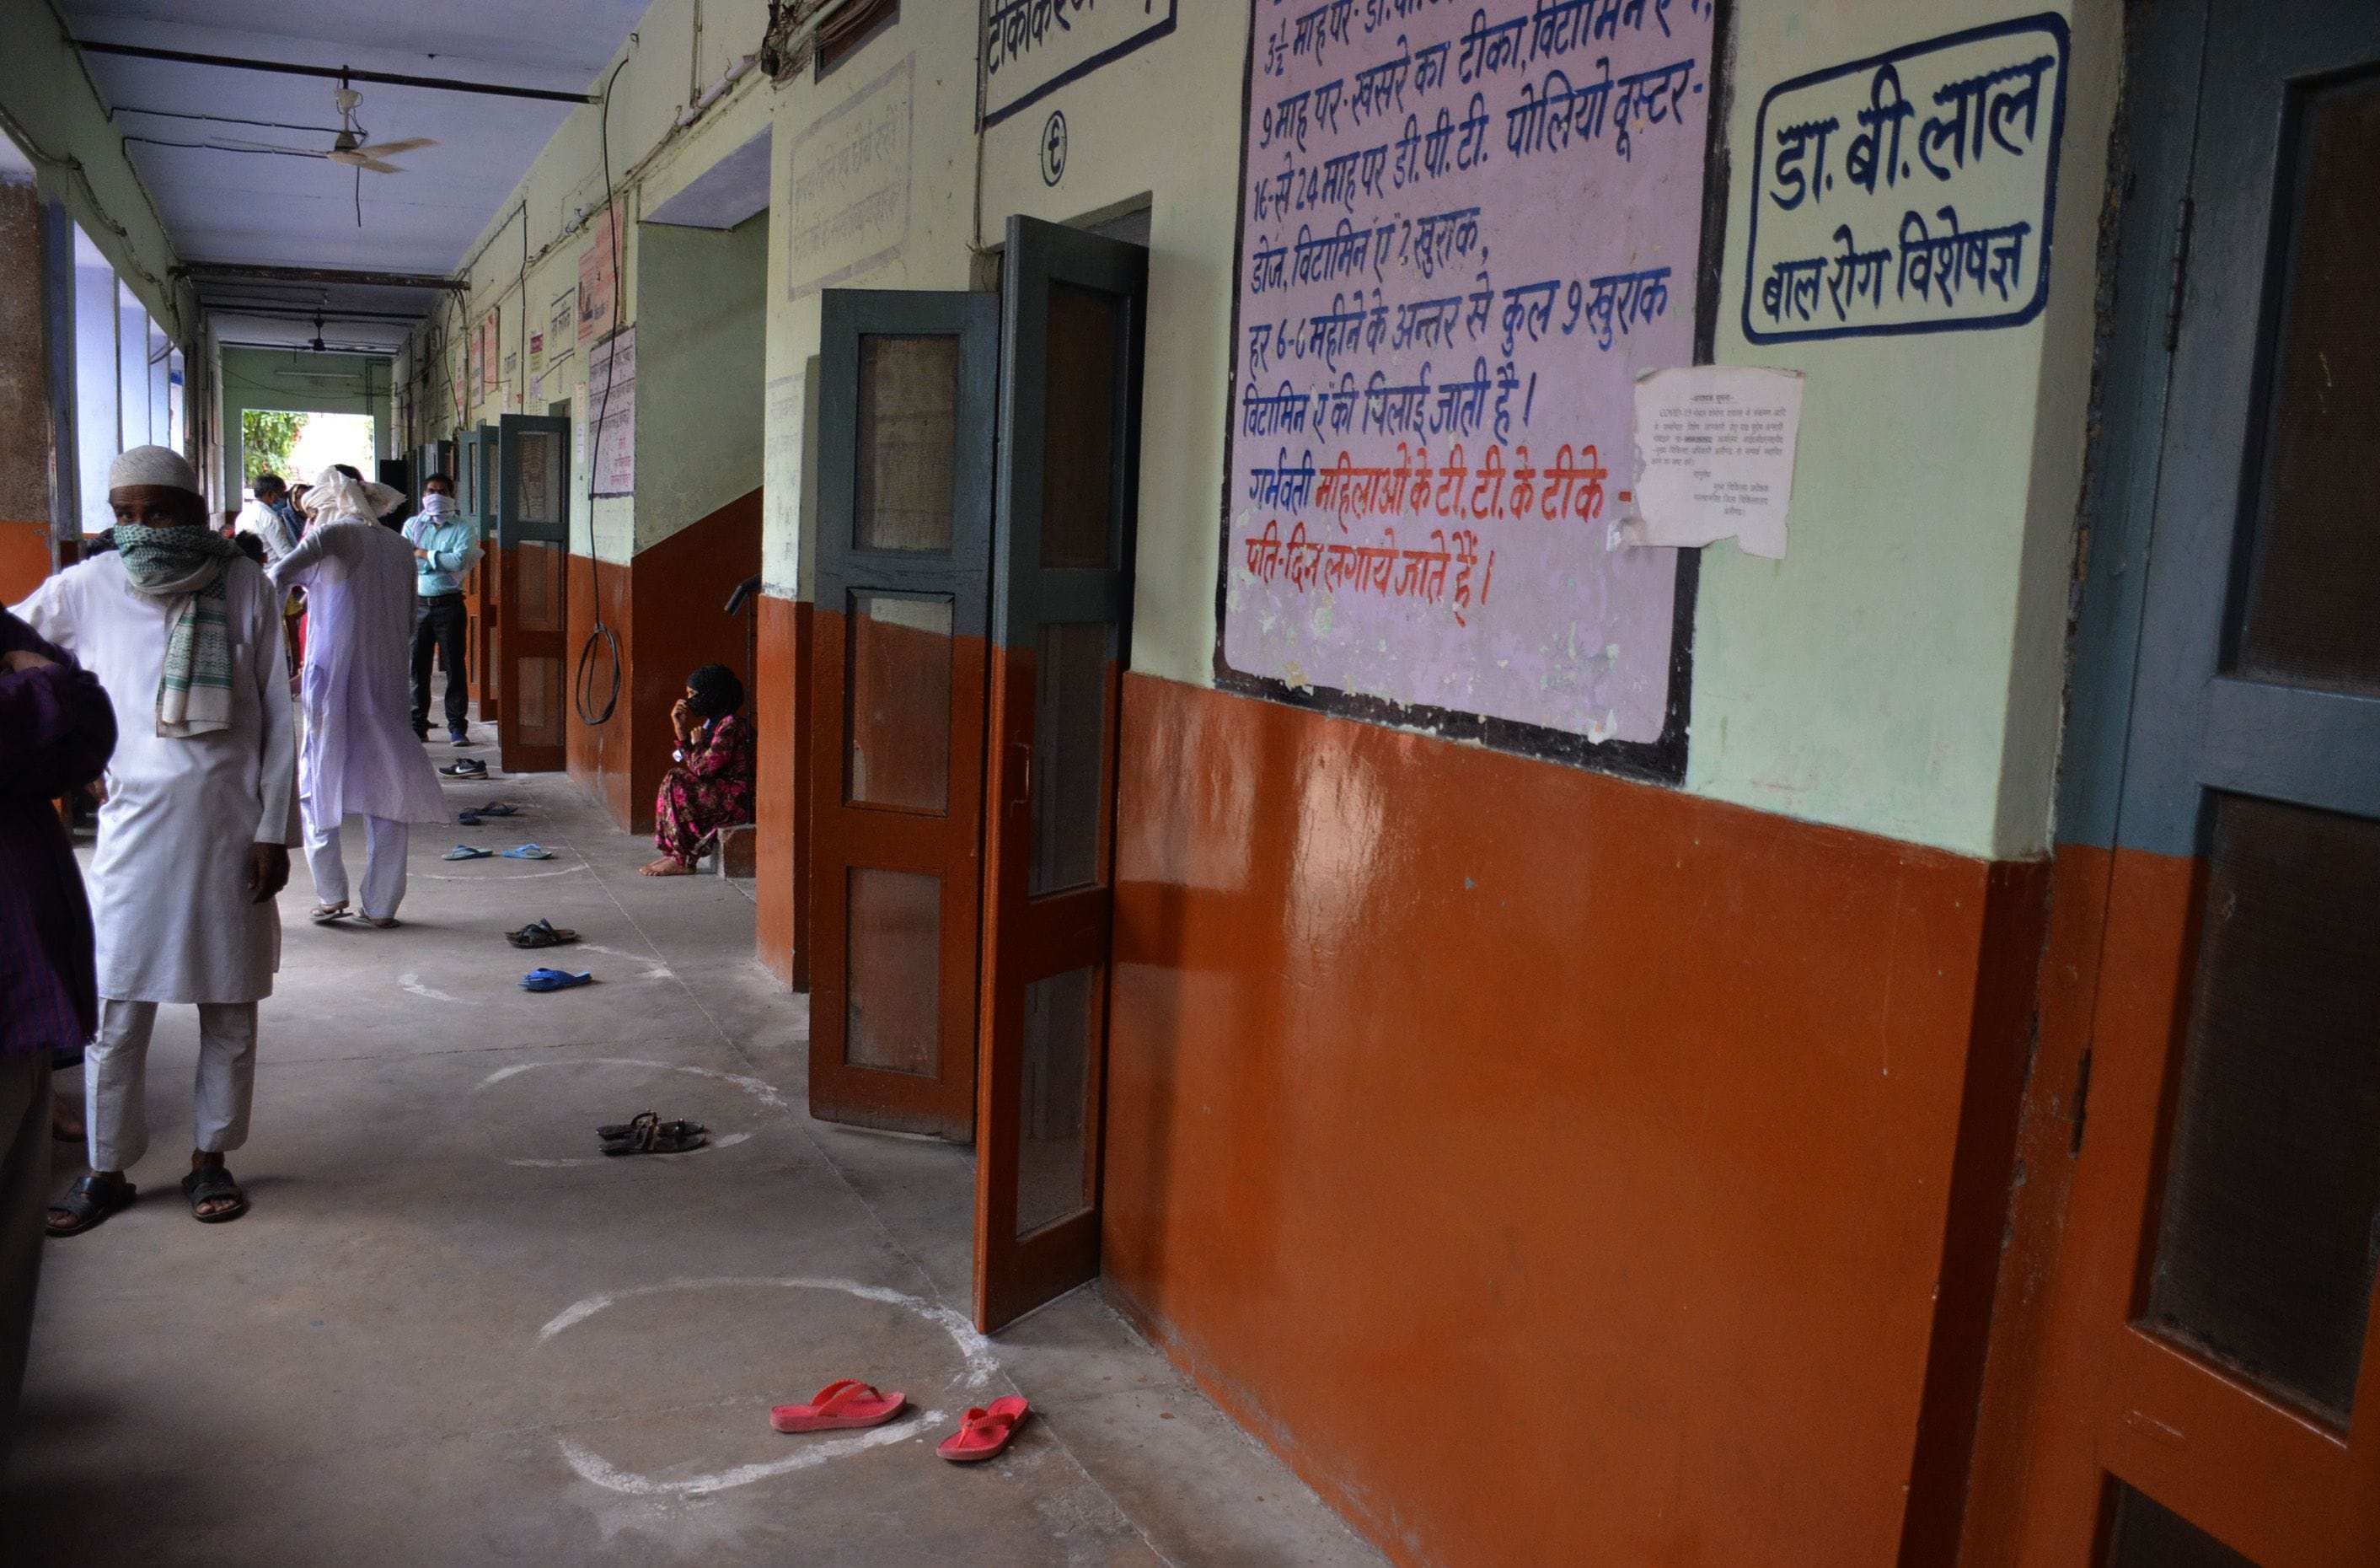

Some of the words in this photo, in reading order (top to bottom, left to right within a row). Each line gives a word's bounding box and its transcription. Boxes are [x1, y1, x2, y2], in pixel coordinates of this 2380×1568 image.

[1415, 40, 1451, 97] का
[1507, 56, 1614, 158] पोलियो
[1291, 217, 1372, 287] विटामिन
[1762, 255, 1828, 324] बाल
[1827, 224, 1892, 322] रोग
[1897, 205, 2031, 308] विशेषज्ञ
[1249, 324, 1272, 382] हर
[1367, 287, 1389, 355] के
[1466, 271, 1494, 341] से
[1501, 280, 1561, 357] कुल
[1586, 266, 1671, 352] खुराक
[1332, 372, 1359, 437] की
[1429, 356, 1492, 437] जाती
[1410, 448, 1433, 516] के
[1509, 445, 1536, 521] के
[1396, 529, 1451, 604] जाते
